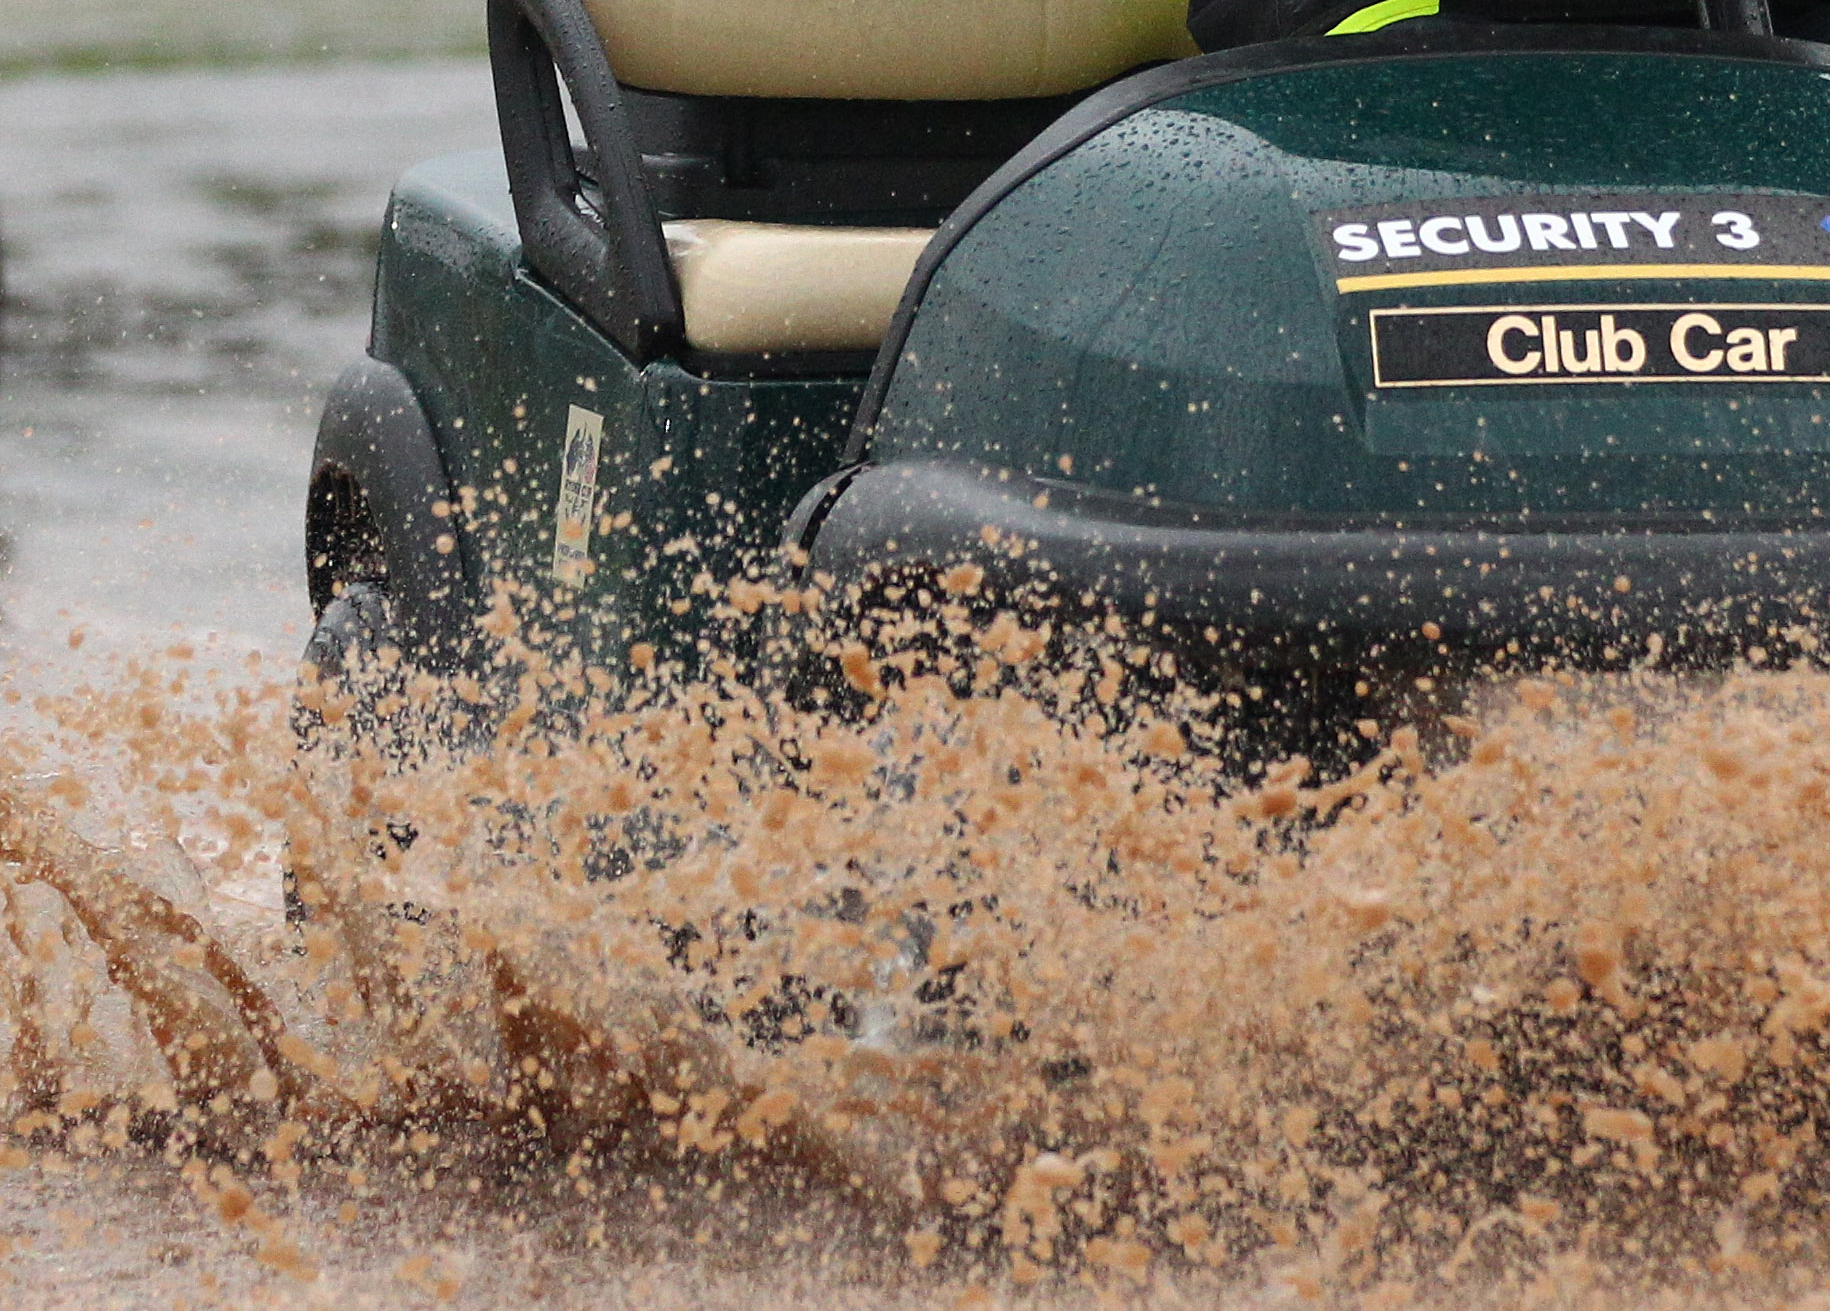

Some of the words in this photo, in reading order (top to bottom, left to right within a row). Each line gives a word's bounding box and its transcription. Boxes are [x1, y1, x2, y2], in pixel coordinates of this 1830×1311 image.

[1332, 211, 1681, 262] SECURITY
[1711, 211, 1760, 250] 3
[1486, 314, 1648, 375] Club
[1669, 312, 1798, 373] Car
